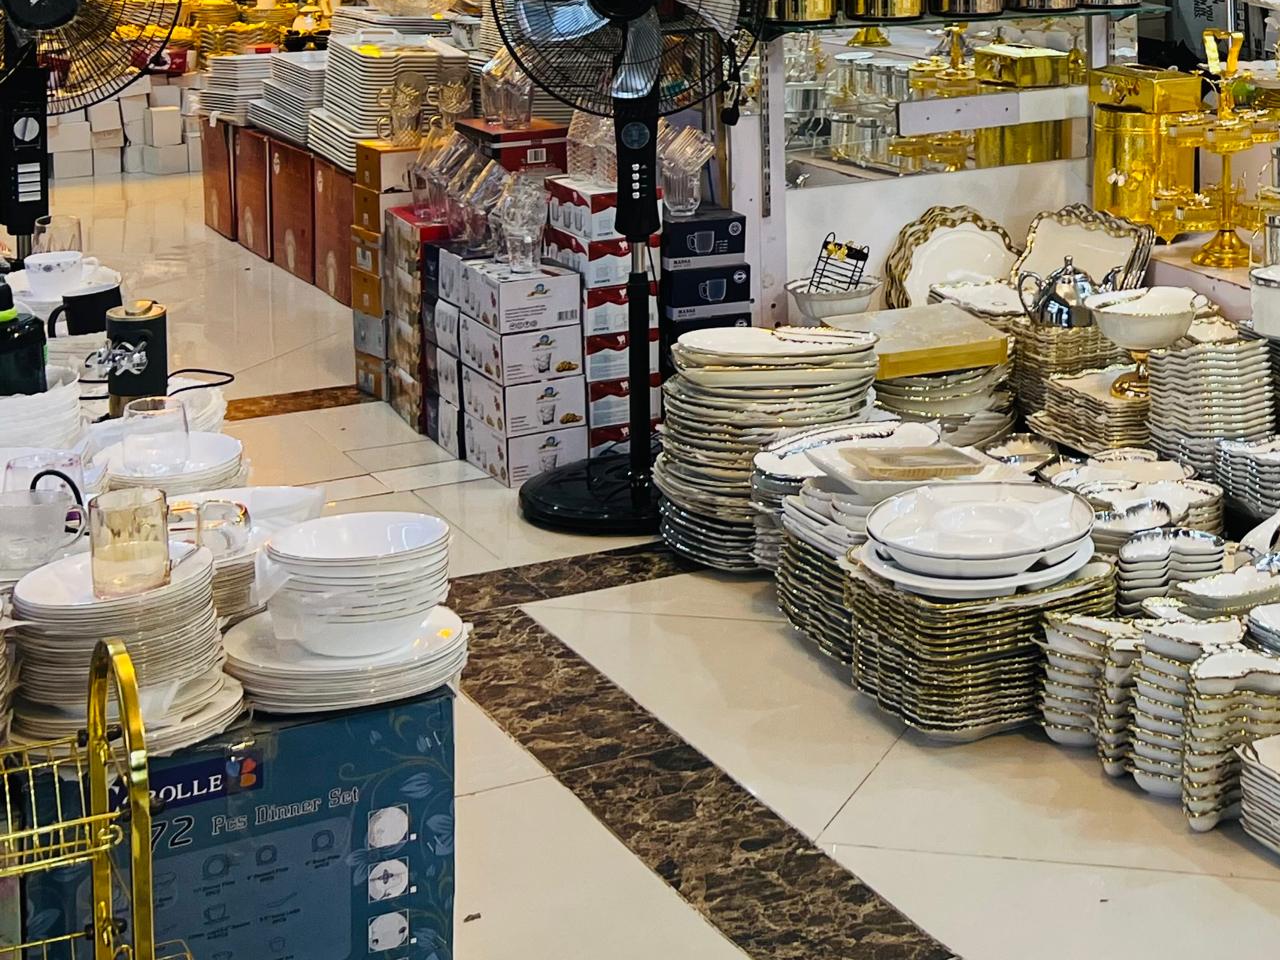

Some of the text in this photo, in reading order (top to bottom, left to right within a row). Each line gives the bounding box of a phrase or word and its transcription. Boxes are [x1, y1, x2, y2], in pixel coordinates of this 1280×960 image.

[151, 786, 360, 853] 72 Pcs Dinner Set
